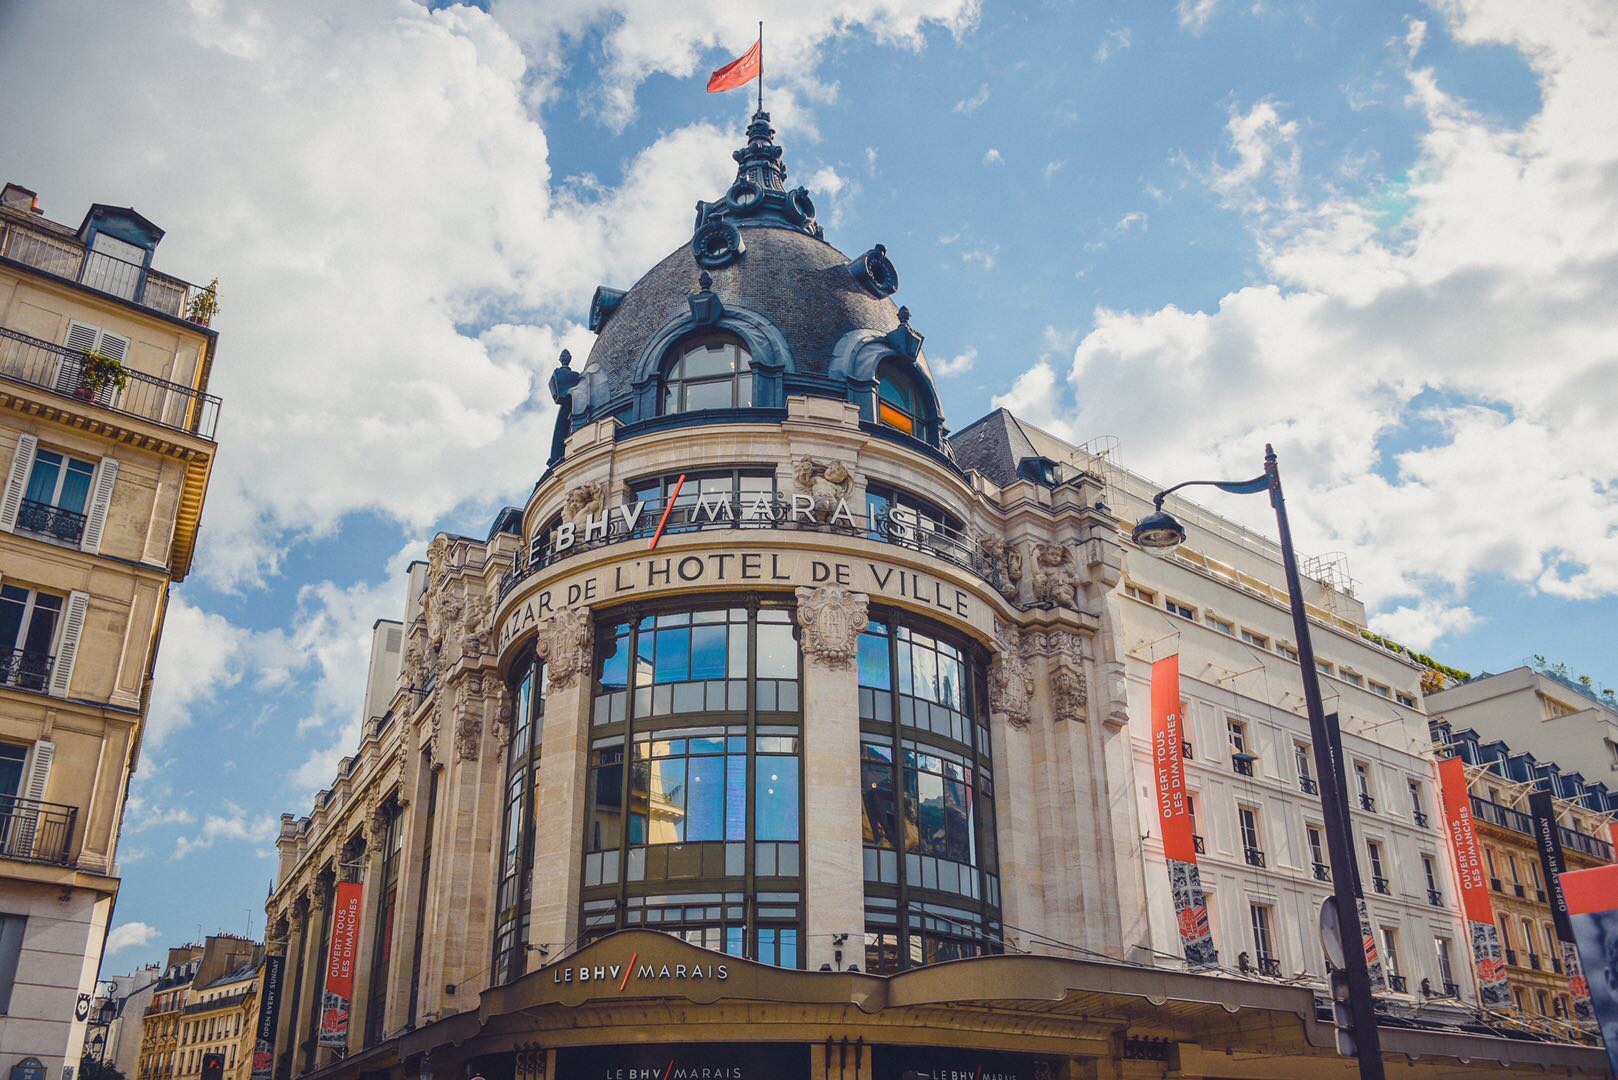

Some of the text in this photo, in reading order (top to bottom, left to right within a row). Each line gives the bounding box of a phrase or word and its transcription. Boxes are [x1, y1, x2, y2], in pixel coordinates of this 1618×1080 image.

[513, 534, 541, 578] LE
[567, 578, 597, 606] DE
[615, 553, 790, 593] L'HOTEL
[812, 561, 850, 585] DE
[868, 563, 968, 618] VILLE
[1156, 730, 1172, 818] OUVERT TOUS
[1167, 713, 1184, 816] LES DIMANCHES
[1453, 820, 1472, 889] OUVERT TOUS
[1460, 806, 1482, 888] LES DIMANCHES
[1540, 817, 1566, 912] OPEN EVERY SUNDAY
[331, 909, 346, 977] OUVERT TOUS
[341, 898, 358, 978] LES DIMANCHES
[263, 959, 279, 1038] OPEN EVERY SUNDAY
[554, 968, 572, 983] LE
[606, 1069, 623, 1080] LE
[933, 1070, 946, 1080] LE
